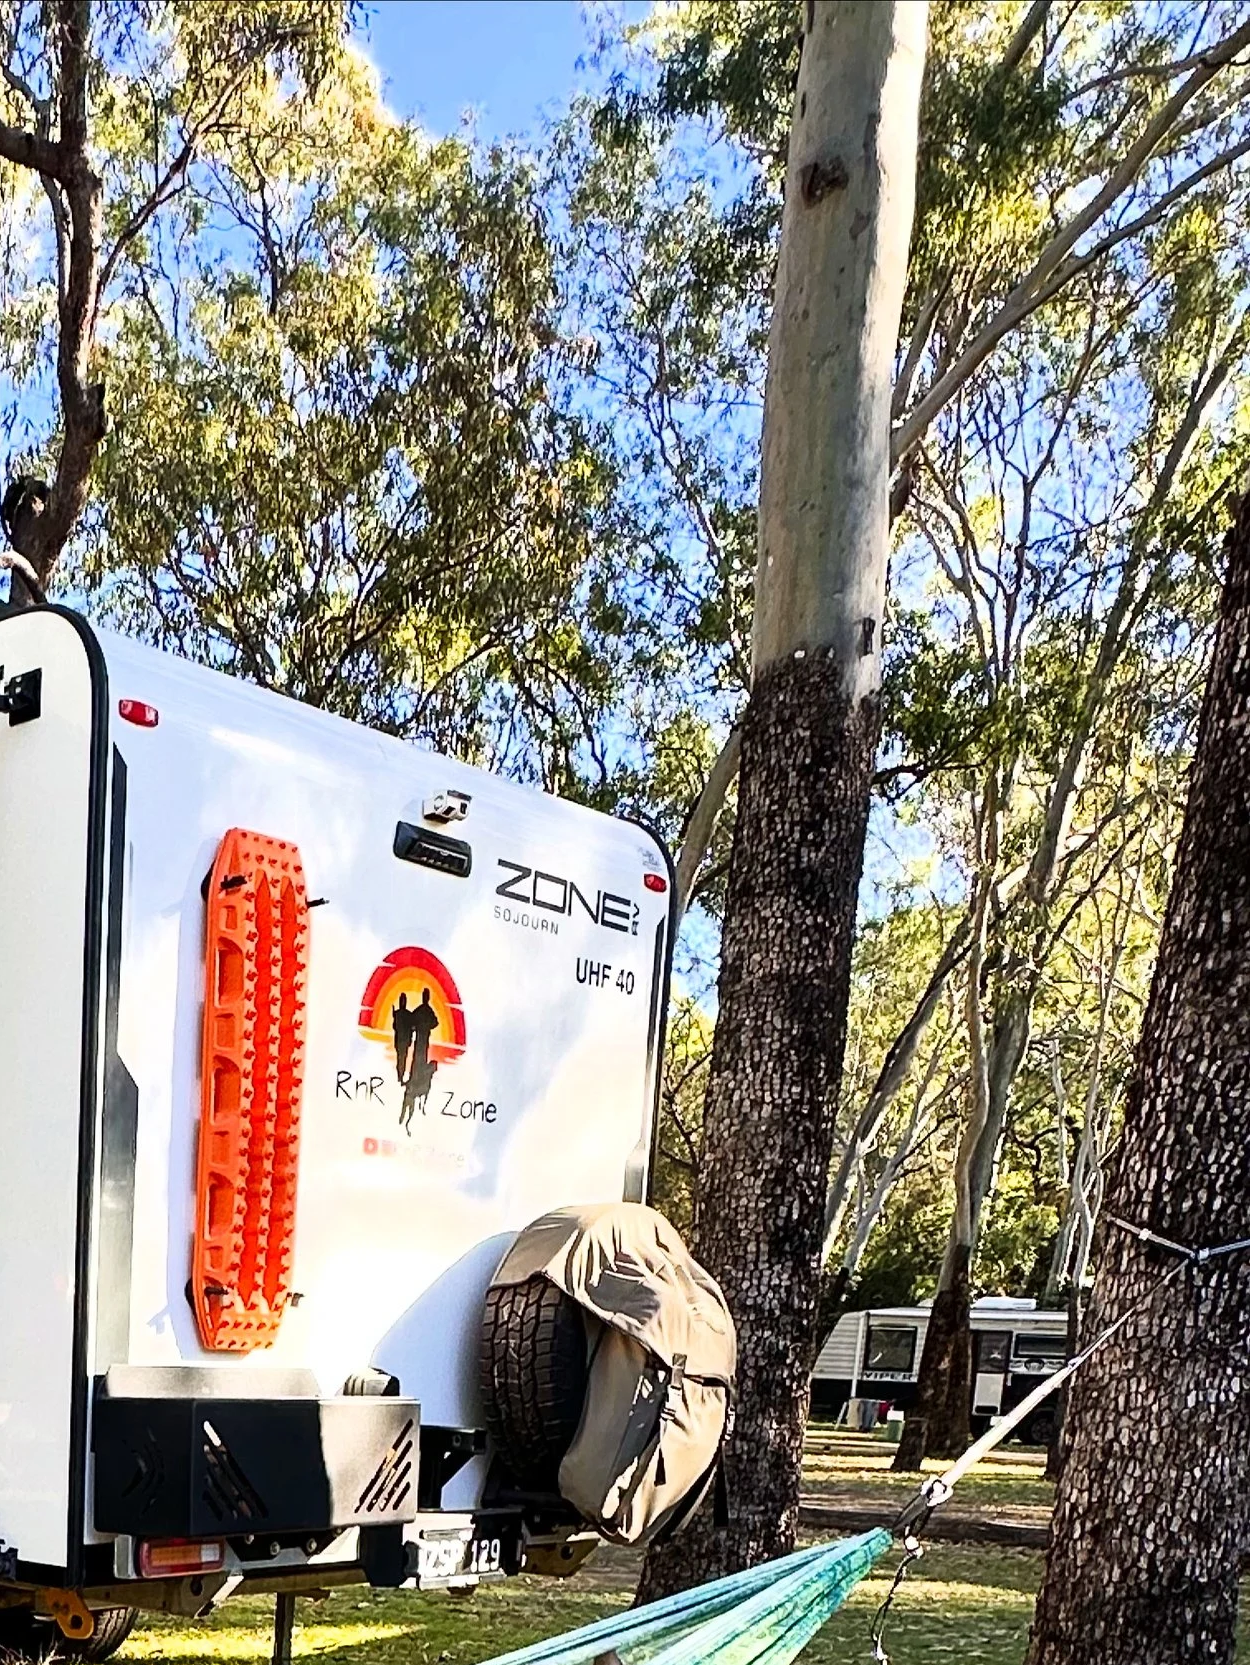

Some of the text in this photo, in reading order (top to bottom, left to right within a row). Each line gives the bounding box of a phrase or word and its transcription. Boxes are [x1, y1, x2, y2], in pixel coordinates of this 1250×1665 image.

[496, 859, 631, 933] ZONE
[494, 905, 559, 935] SOJOURN
[576, 957, 635, 995] UHF 40
[336, 1071, 497, 1123] RnR Zone
[470, 1538, 501, 1573] 129
